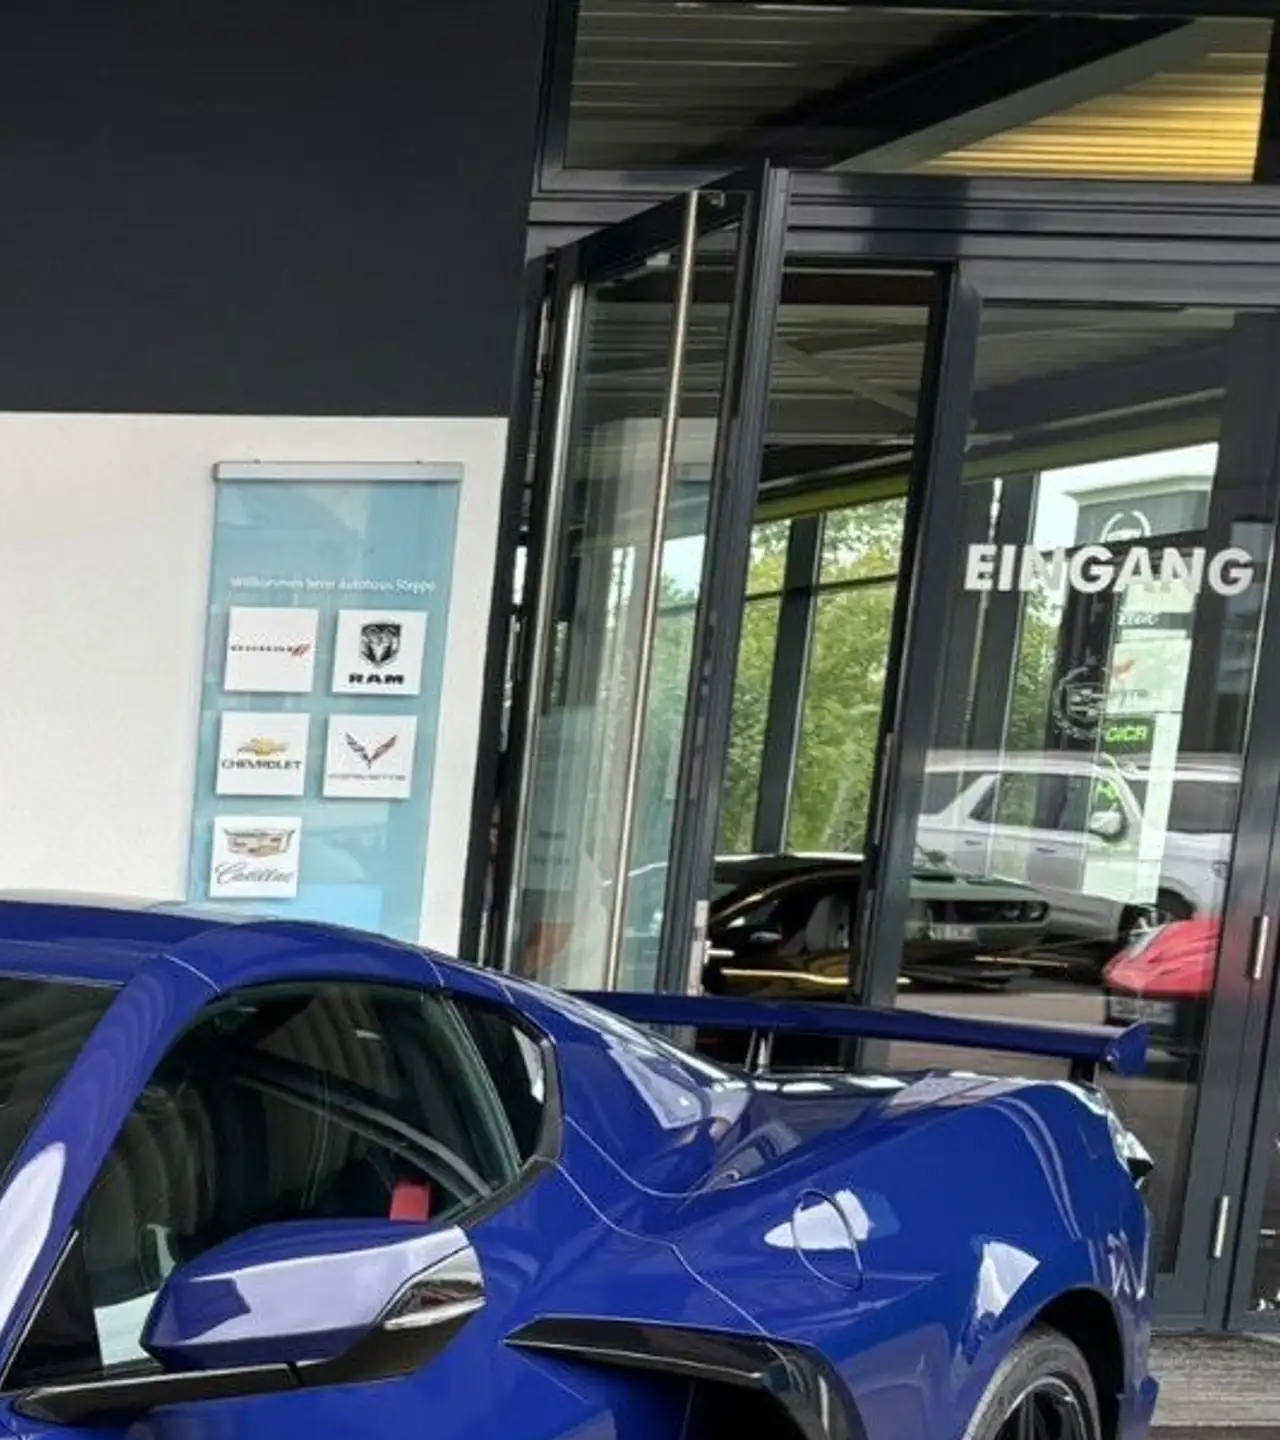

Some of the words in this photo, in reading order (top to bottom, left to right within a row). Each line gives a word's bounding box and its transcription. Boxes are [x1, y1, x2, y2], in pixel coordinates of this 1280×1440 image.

[964, 543, 1254, 596] EINGANG
[348, 673, 405, 685] RAM
[221, 758, 302, 770] CHEVROLET
